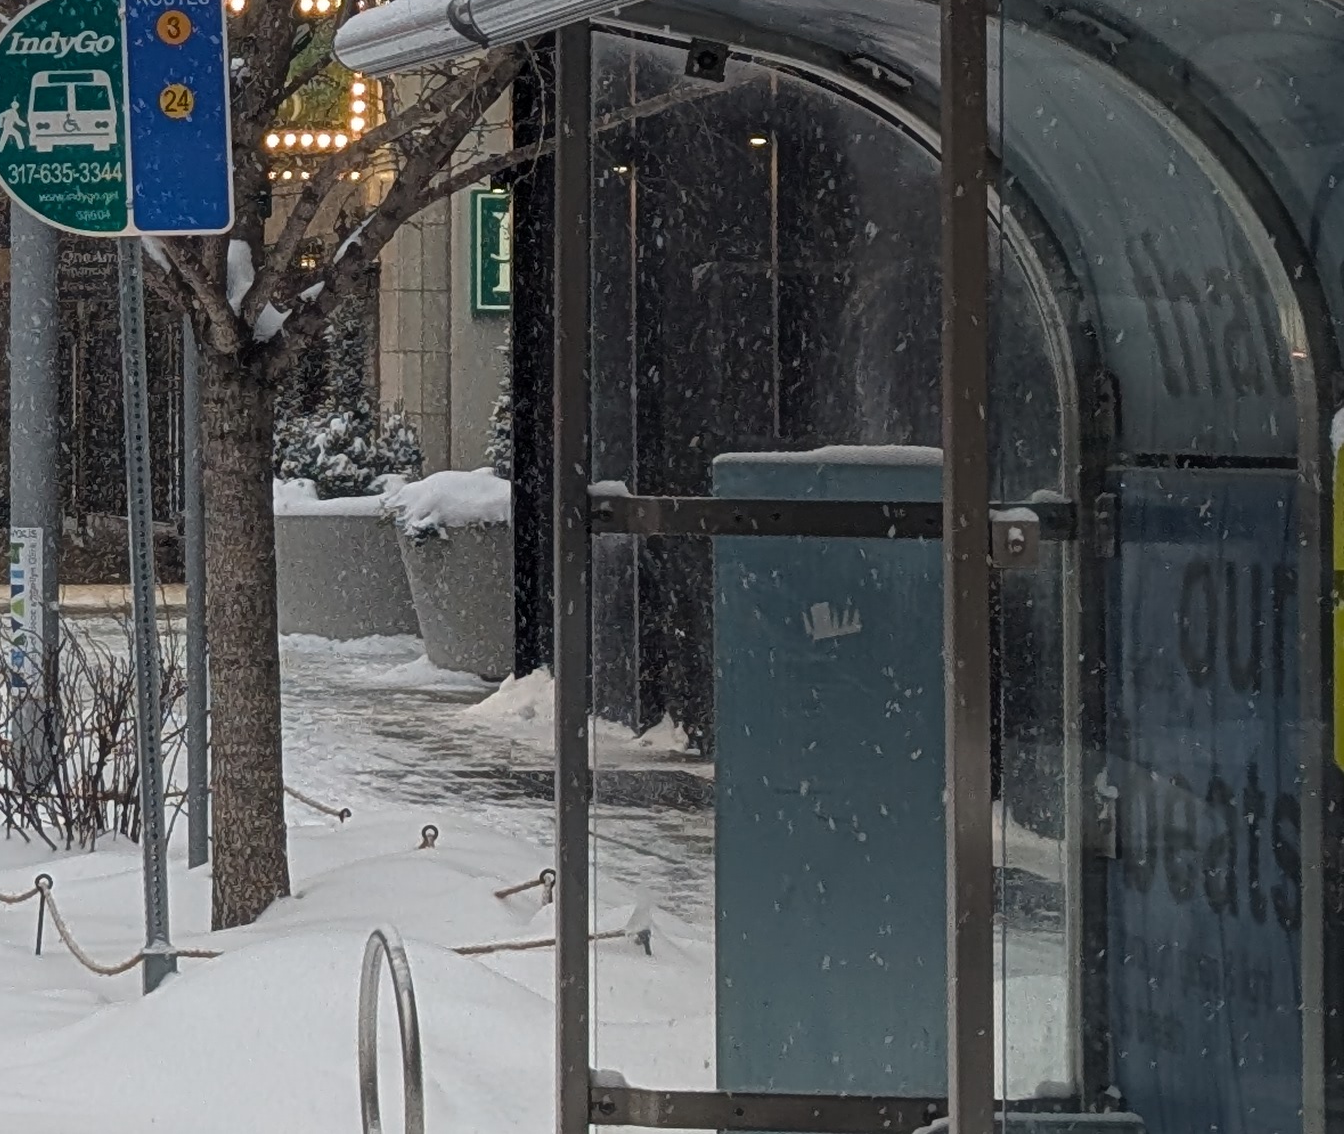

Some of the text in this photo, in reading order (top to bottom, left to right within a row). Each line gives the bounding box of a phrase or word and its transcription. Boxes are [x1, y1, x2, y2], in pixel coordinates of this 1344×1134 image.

[166, 16, 181, 39] 3
[5, 29, 116, 58] IndyGo
[164, 89, 190, 112] 24
[7, 161, 123, 184] 317-635-3344
[1179, 559, 1298, 698] our
